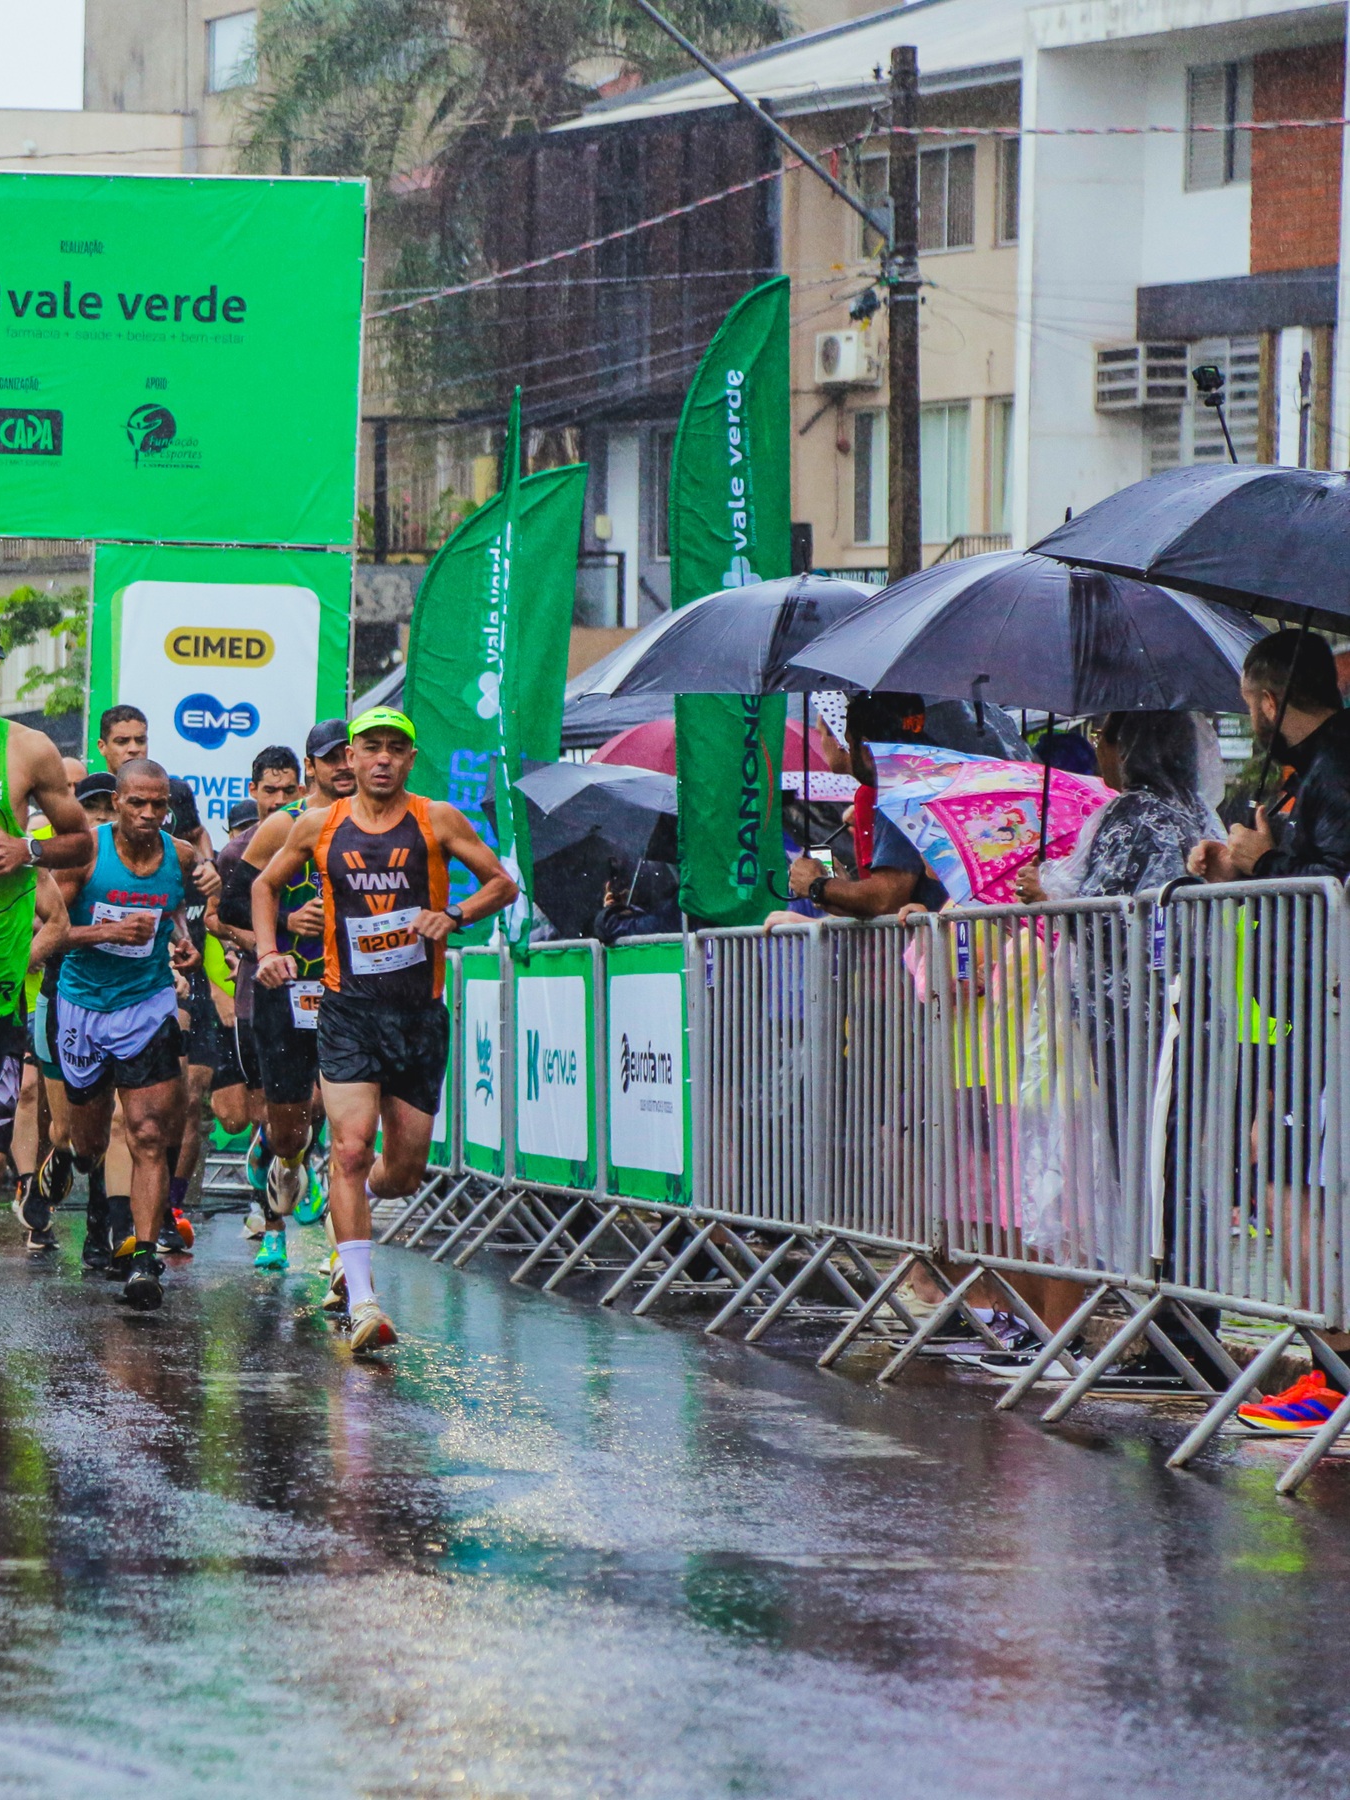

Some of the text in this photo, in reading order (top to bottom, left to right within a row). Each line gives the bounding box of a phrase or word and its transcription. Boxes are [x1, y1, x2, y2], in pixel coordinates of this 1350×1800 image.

[7, 280, 247, 324] vale verde
[127, 330, 167, 343] beleza
[725, 368, 748, 551] vale verde
[172, 634, 267, 660] CIMED
[182, 710, 251, 730] EMS
[361, 929, 410, 952] 1207
